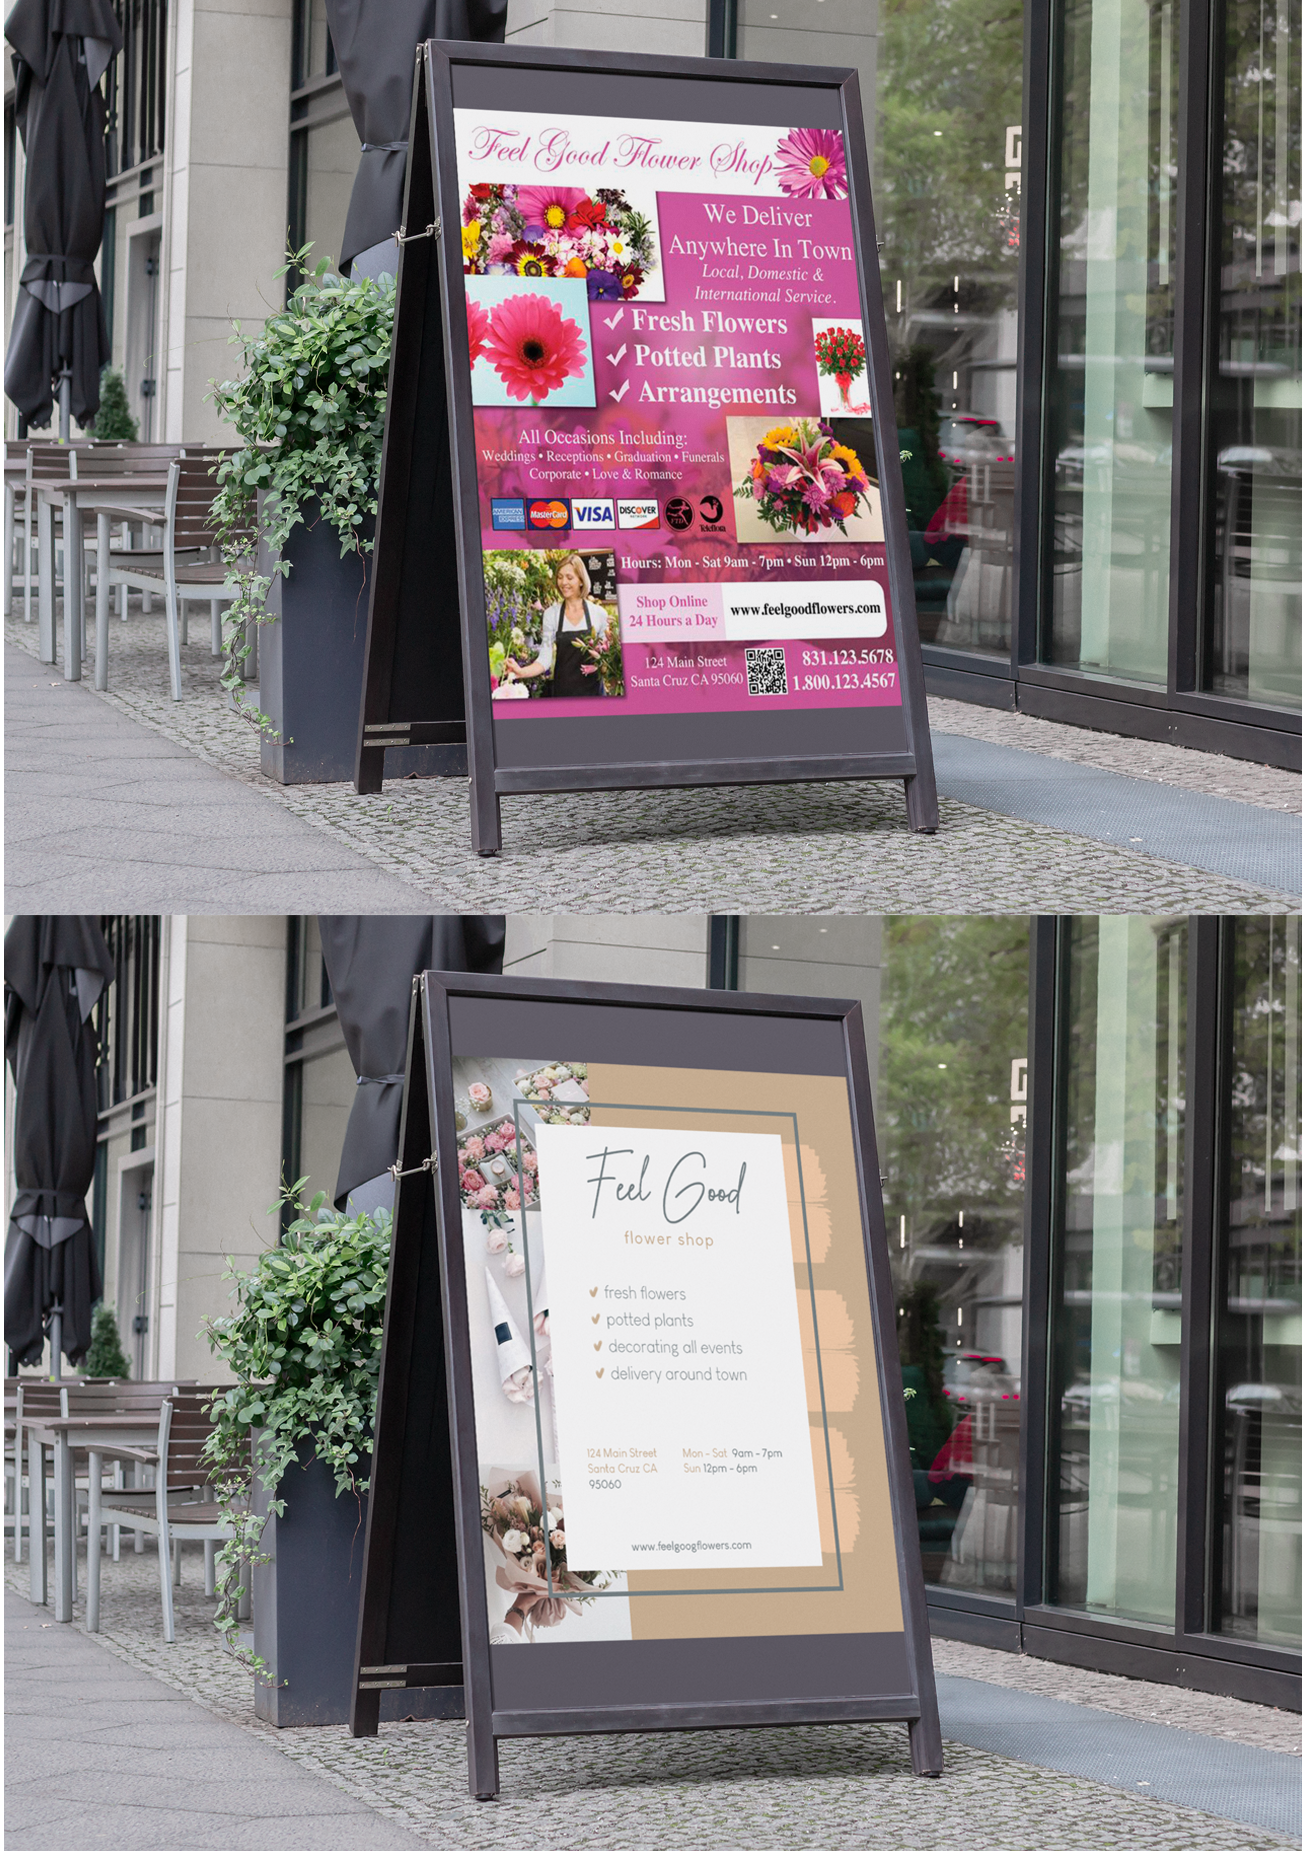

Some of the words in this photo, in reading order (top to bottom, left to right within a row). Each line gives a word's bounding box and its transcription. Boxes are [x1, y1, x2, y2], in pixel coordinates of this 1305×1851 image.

[468, 126, 531, 161] Feel
[534, 128, 610, 172] Good
[613, 134, 702, 171] Flower
[709, 141, 773, 185] Shop
[703, 203, 737, 224] We
[742, 205, 813, 227] Deliver
[669, 234, 768, 261] Anywhere
[773, 238, 793, 259] In
[797, 239, 853, 261] Town
[702, 264, 744, 280] Local,
[748, 265, 809, 281] Domestic
[812, 267, 825, 282] &
[695, 286, 781, 302] International
[785, 288, 837, 304] Service.
[631, 309, 695, 332] Fresh
[701, 310, 788, 335] Flowers
[634, 344, 707, 367] Potted
[713, 346, 782, 369] Plants
[638, 380, 797, 409] Arrangements
[519, 430, 541, 444] All
[544, 429, 616, 445] Occasions
[619, 431, 688, 449] Including:
[482, 450, 536, 465] Weddings
[546, 450, 605, 464] Receptions
[614, 452, 672, 463] Graduation
[682, 452, 725, 463] Funerals
[529, 467, 582, 482] Corporate
[592, 468, 619, 480] Love
[622, 469, 632, 480] &
[635, 468, 683, 480] Romance
[530, 511, 567, 519] MasterCard
[574, 506, 613, 522] VISA
[619, 506, 657, 515] DISCOVER
[621, 557, 662, 569] Hours:
[665, 556, 693, 568] Mon
[702, 556, 721, 568] Sat
[724, 556, 749, 568] 9am
[759, 556, 784, 571] 7pm
[794, 555, 818, 567] Sun
[820, 555, 850, 570] 12pm
[860, 554, 885, 569] 6pm
[636, 596, 666, 611] Shop
[669, 595, 708, 607] Online
[730, 602, 881, 619] www.feelgoodflowers.com
[629, 615, 643, 628] 24
[646, 614, 682, 627] Hours
[685, 617, 692, 626] a
[695, 613, 719, 629] Day
[645, 657, 663, 669] 124
[667, 656, 695, 668] Main
[698, 655, 728, 668] Street
[802, 649, 894, 666] 831.123.5678
[631, 675, 660, 687] Santa
[662, 674, 689, 686] Cruz
[691, 673, 709, 686] CA
[711, 672, 743, 685] 95060
[793, 673, 896, 691] 1.800.123.4567
[586, 1146, 651, 1219] Feel
[663, 1151, 747, 1224] Good
[624, 1230, 672, 1245] flower
[678, 1232, 714, 1250] shop
[604, 1285, 637, 1299] fresh
[640, 1286, 687, 1300] flowers
[606, 1312, 650, 1329] potted
[654, 1313, 694, 1330] plants
[608, 1339, 679, 1357] decorating
[682, 1340, 697, 1354] all
[700, 1341, 743, 1354] events
[610, 1366, 662, 1384] delivery
[665, 1367, 712, 1381] around
[715, 1369, 747, 1381] town
[586, 1448, 602, 1458] 124
[603, 1448, 627, 1458] Main
[629, 1448, 657, 1458] Street
[682, 1448, 703, 1458] Mon
[712, 1448, 728, 1458] Sat
[731, 1448, 753, 1458] 9am
[762, 1448, 783, 1460] 7pm
[587, 1463, 615, 1473] Santa
[617, 1463, 640, 1473] Cruz
[642, 1463, 658, 1473] CA
[683, 1463, 701, 1473] Sun
[703, 1463, 727, 1475] 12pm
[736, 1463, 758, 1475] 6pm
[588, 1479, 622, 1489] 95060
[631, 1540, 752, 1553] www.feelgoogflowers.com
